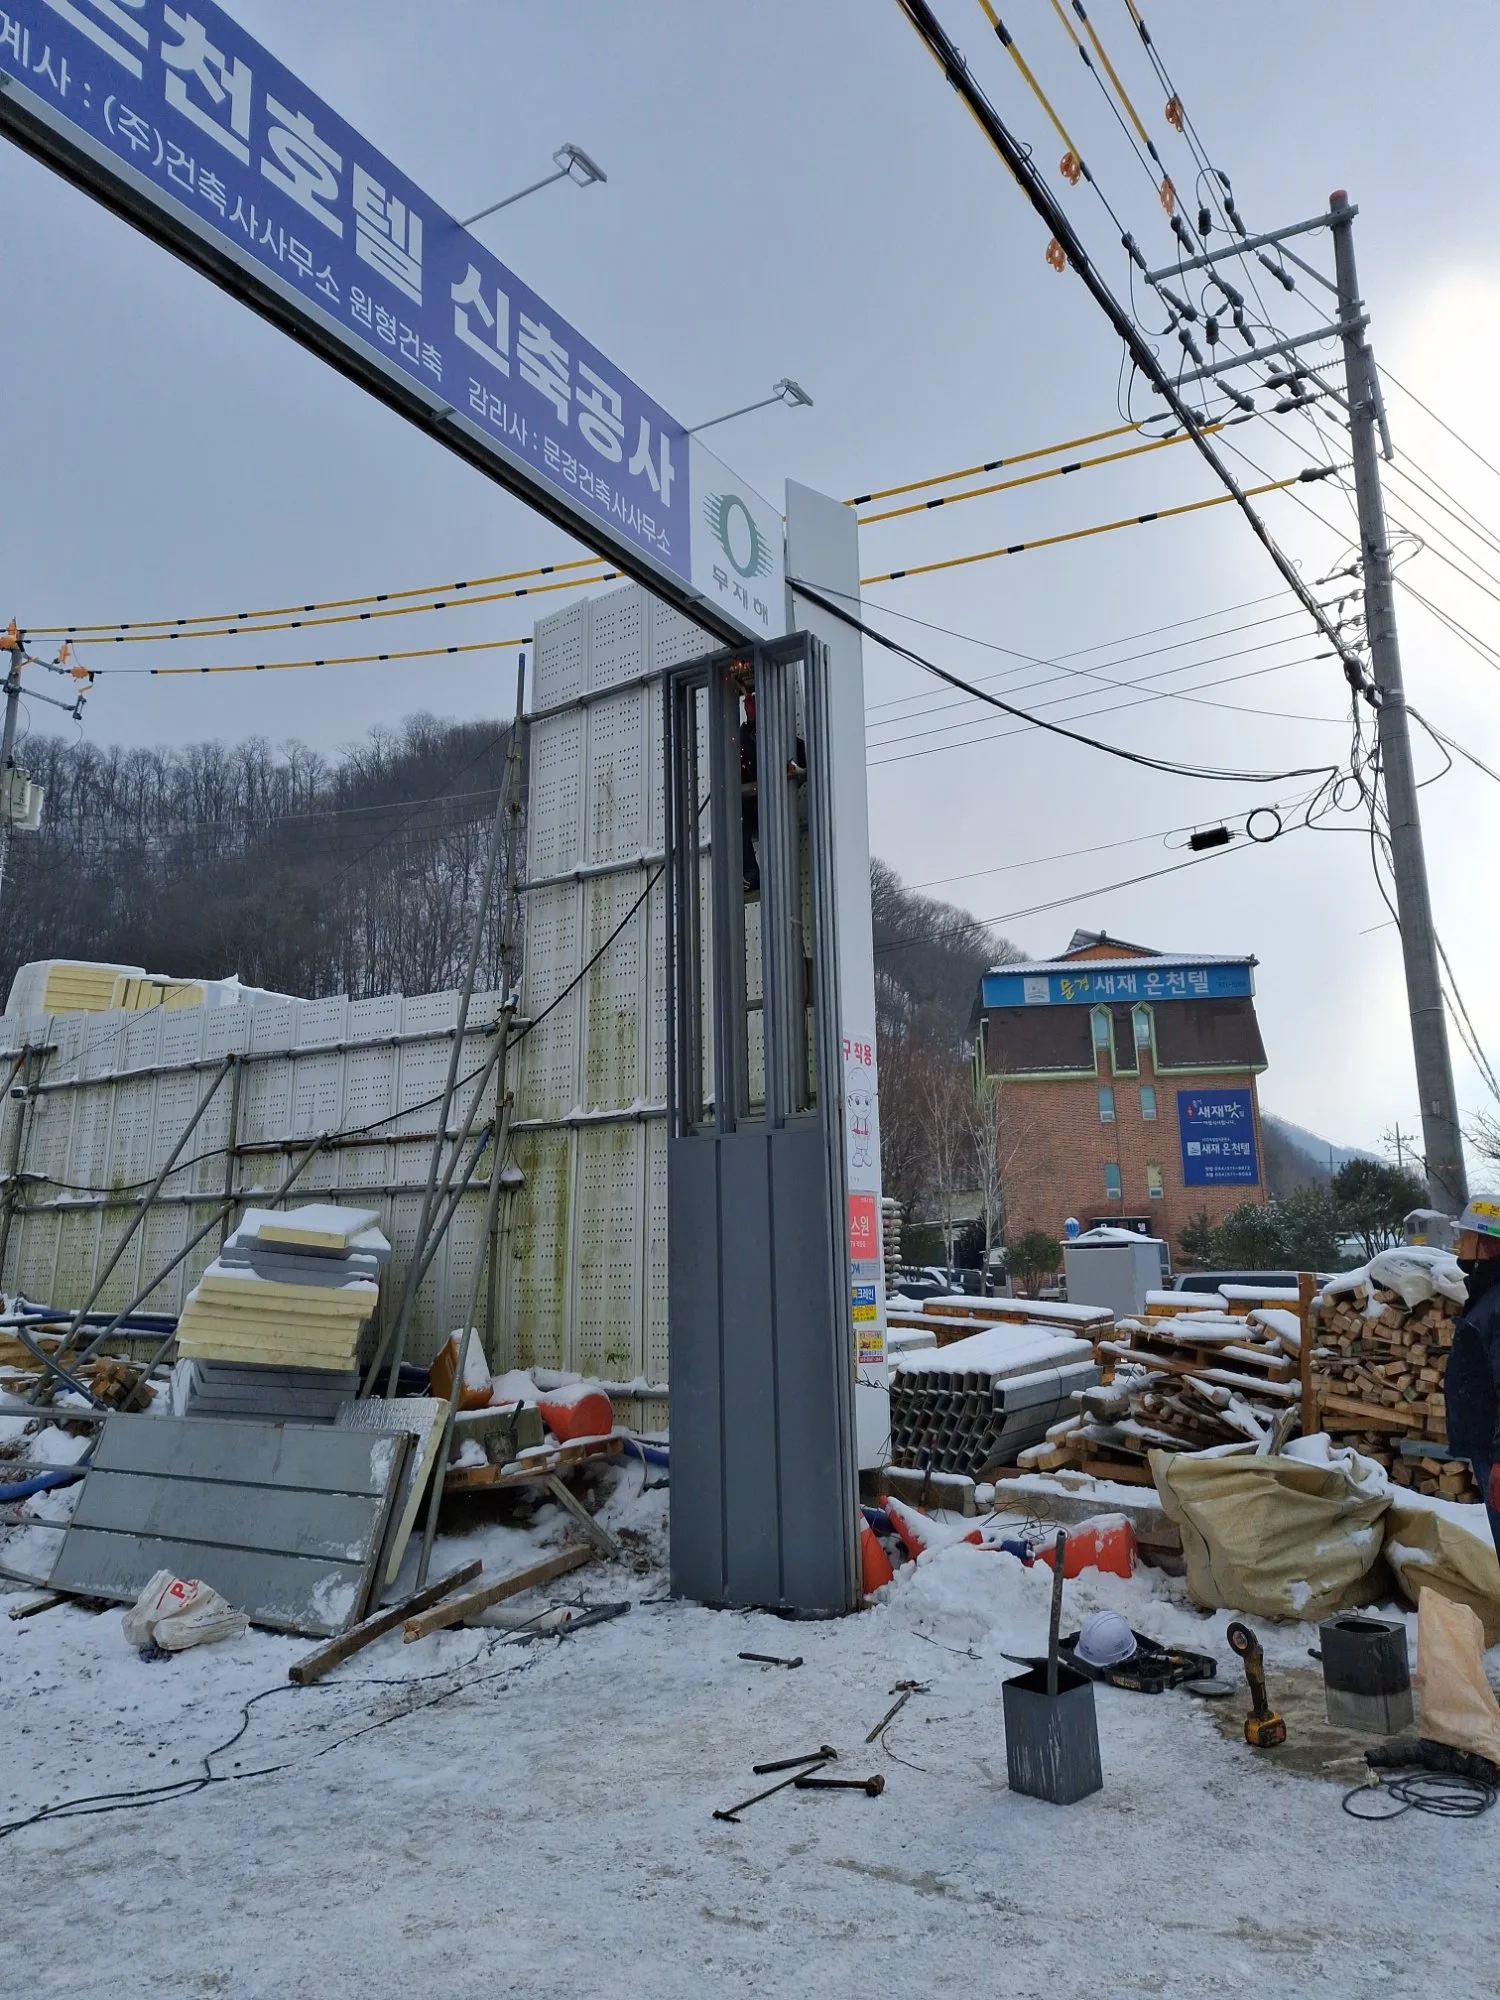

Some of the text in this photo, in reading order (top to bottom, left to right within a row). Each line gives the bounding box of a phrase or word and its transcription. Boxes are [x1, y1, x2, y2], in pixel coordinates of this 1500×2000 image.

[103, 94, 341, 304] (주)건축사사무소
[349, 285, 443, 382] 원형건축
[451, 262, 676, 508] 신축공사
[468, 376, 529, 448] 감리사
[542, 435, 672, 557] 문경건축사사무소
[1060, 975, 1090, 1001] 문경
[1095, 973, 1138, 995] 새재
[1143, 970, 1210, 996] 온천텔
[854, 1041, 872, 1067] 착용
[1201, 1142, 1251, 1156] 새재 온천텔
[850, 1215, 870, 1237] 스원
